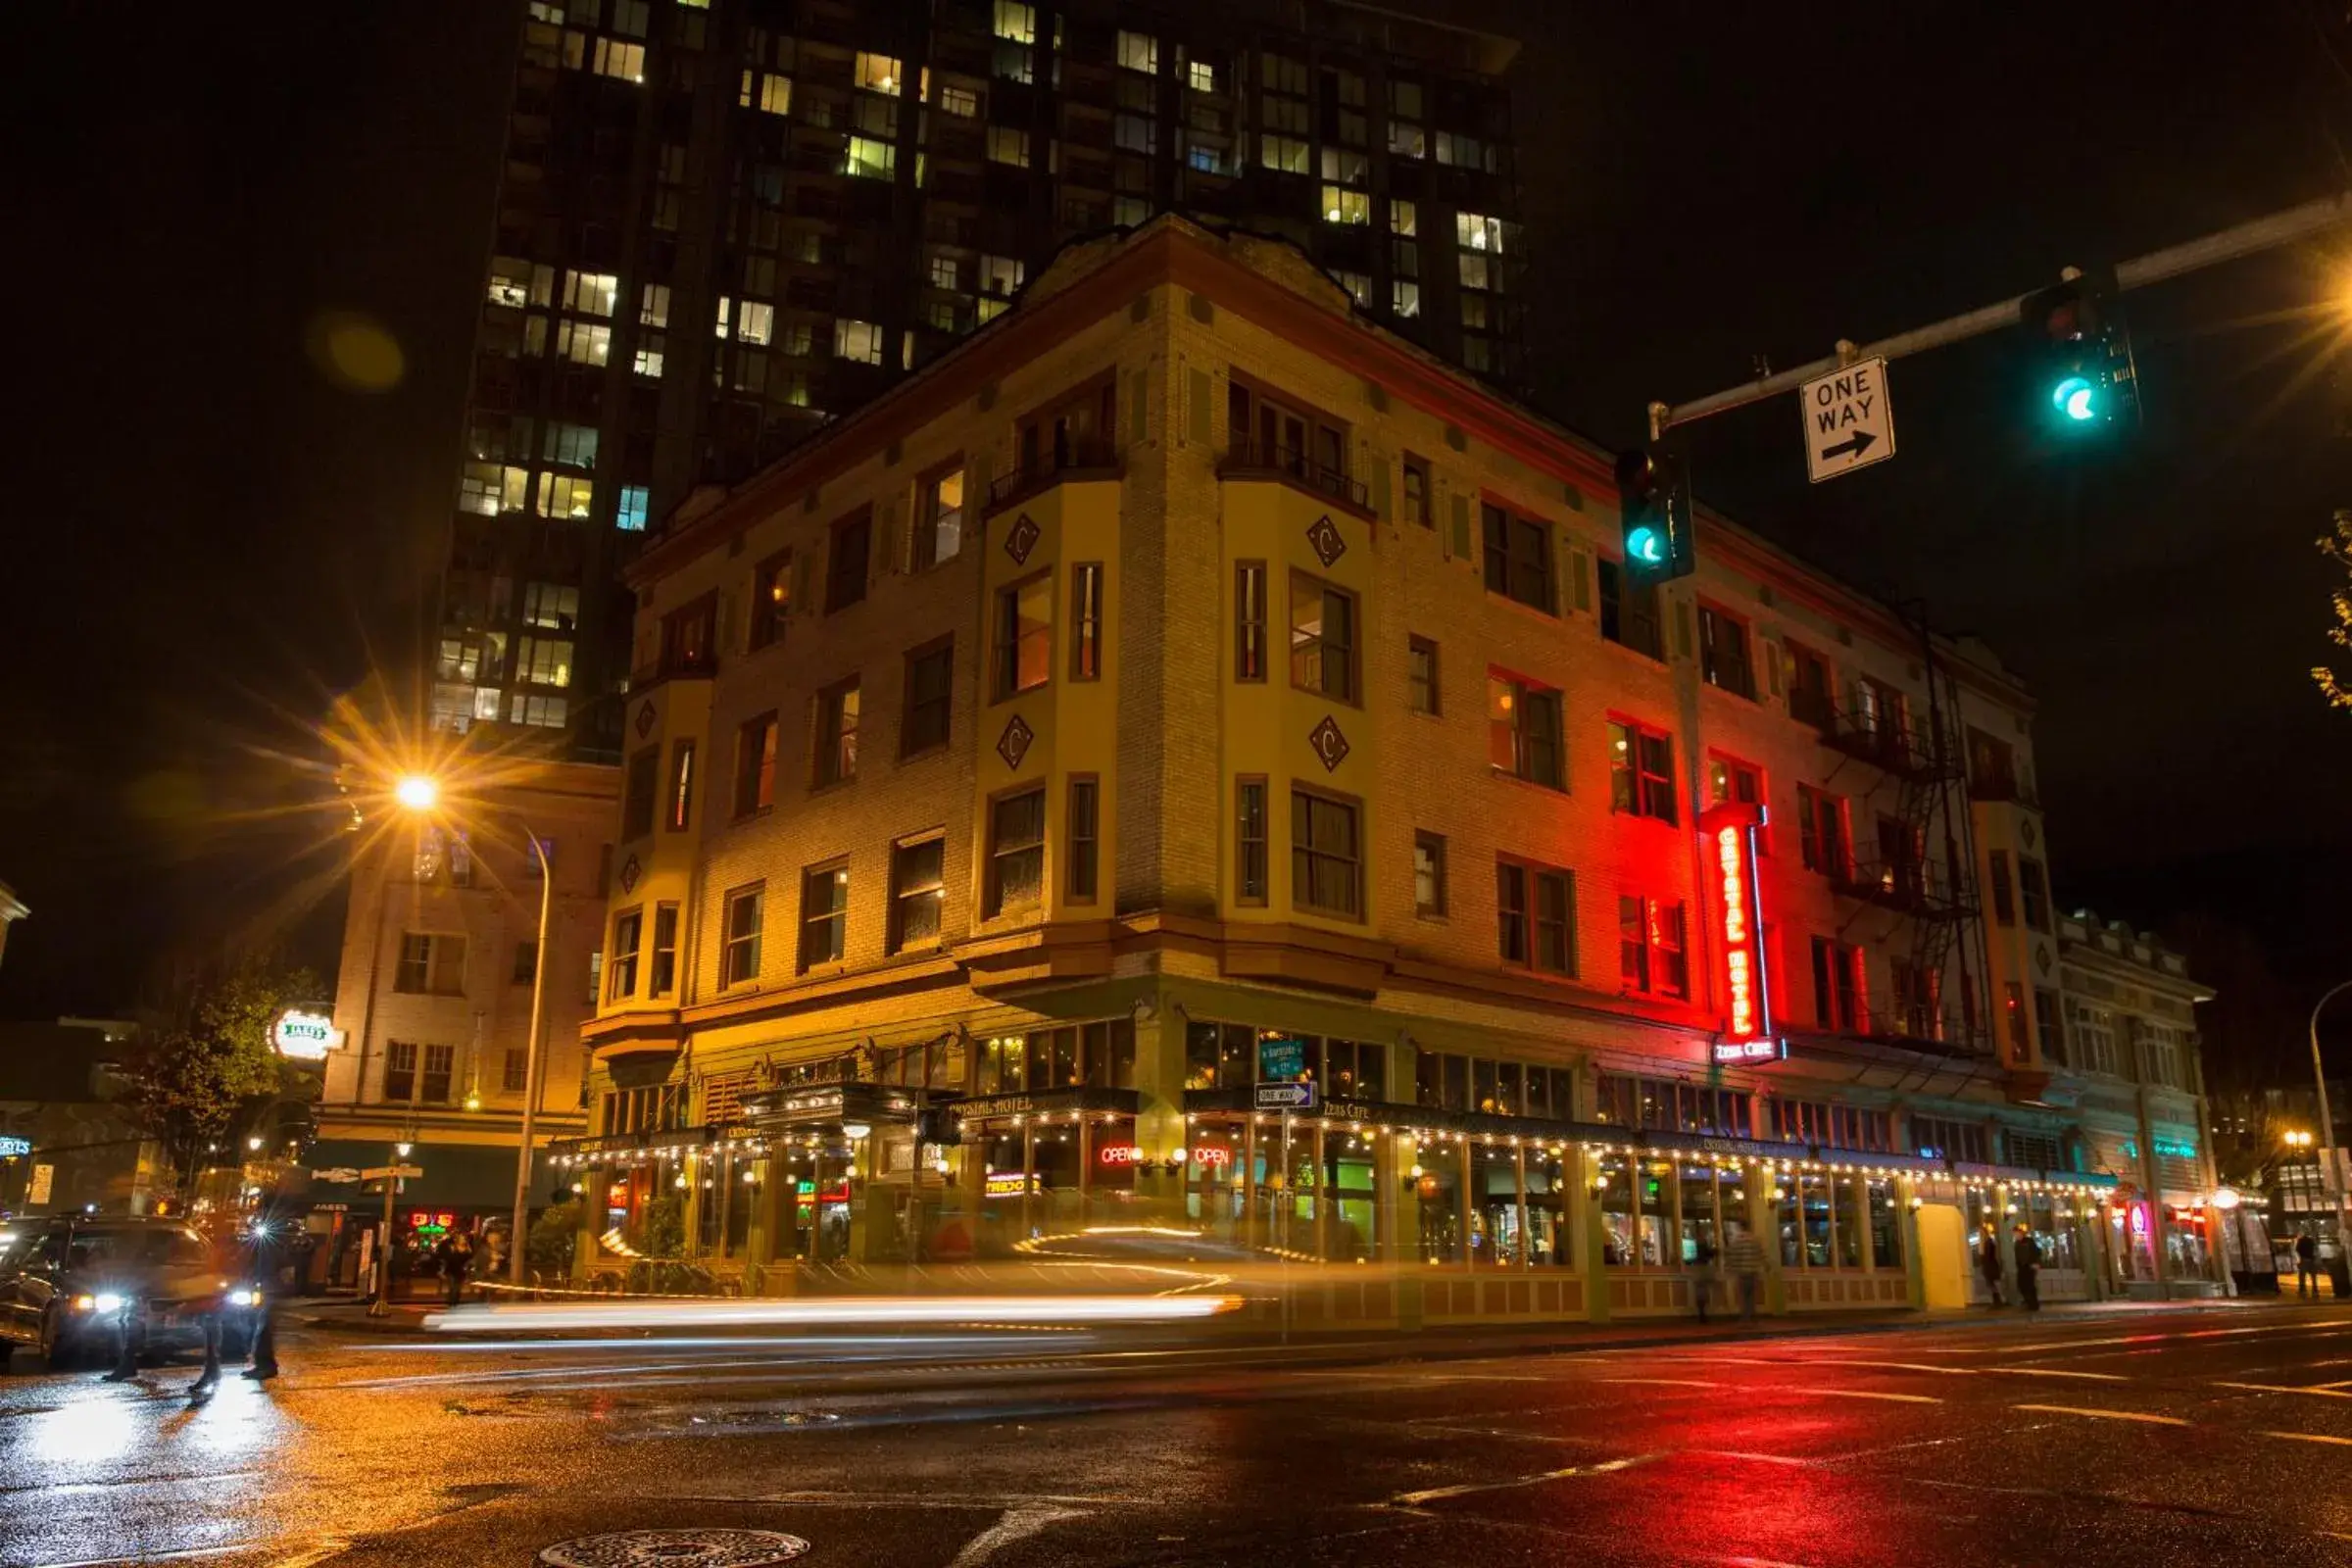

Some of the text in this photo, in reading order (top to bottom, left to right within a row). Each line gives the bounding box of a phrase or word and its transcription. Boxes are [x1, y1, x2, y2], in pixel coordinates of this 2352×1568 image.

[1818, 369, 1870, 407] ONE
[1818, 395, 1873, 434] WAY
[1319, 527, 1332, 555] C
[1008, 728, 1022, 758] C
[1322, 730, 1335, 759] C
[995, 1097, 1034, 1114] HOTEL
[1259, 1089, 1295, 1101] ONE WAY
[1102, 1147, 1135, 1163] OPEN
[1195, 1148, 1229, 1163] OPEN
